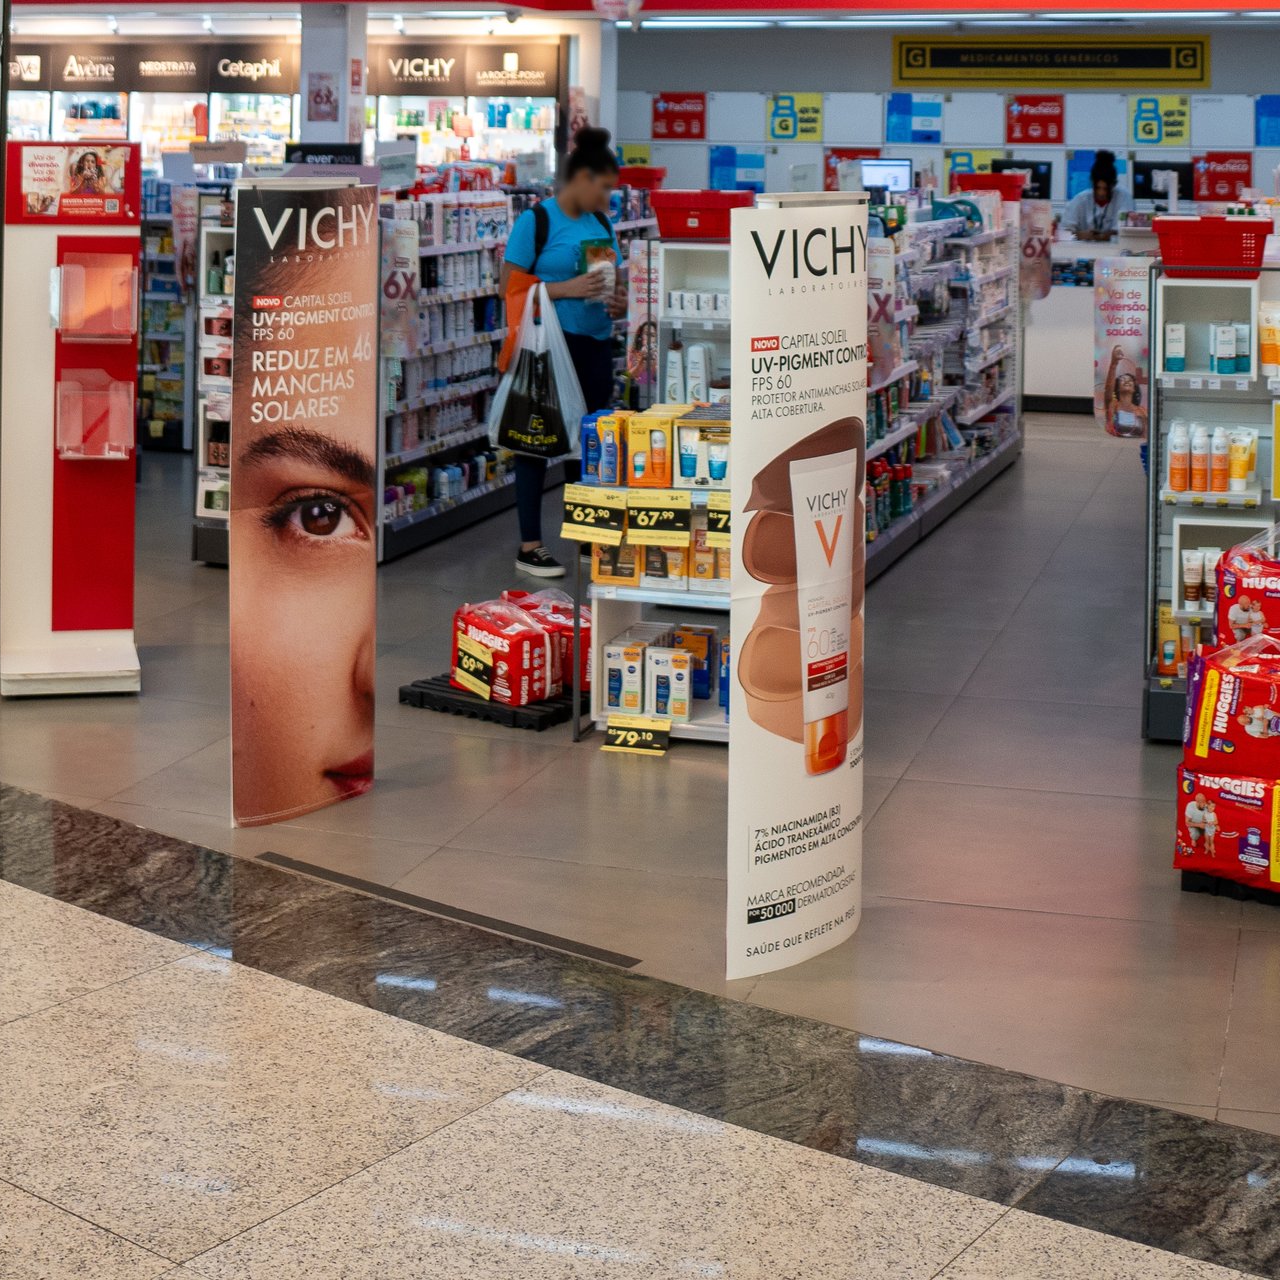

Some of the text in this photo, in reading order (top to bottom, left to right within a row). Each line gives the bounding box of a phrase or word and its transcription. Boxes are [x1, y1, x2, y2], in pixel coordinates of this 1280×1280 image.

[63, 55, 116, 77] Avène
[139, 61, 196, 73] NEOSTRATA
[388, 58, 456, 77] VICHY
[908, 49, 925, 66] G
[960, 53, 1050, 64] MEDICAMENTOS
[1178, 50, 1195, 67] G
[218, 58, 282, 82] Cetaphil
[1022, 104, 1061, 115] Pacheco
[1209, 160, 1249, 172] Pacheco
[253, 203, 374, 250] VICHY
[750, 224, 867, 280] VICHY
[1022, 238, 1050, 260] 6X
[1113, 268, 1148, 277] Pacheco
[383, 270, 417, 300] 6X
[1107, 288, 1142, 299] Vai de
[256, 298, 281, 307] NOVO
[283, 294, 326, 309] CAPITAL
[1099, 300, 1150, 312] diversão.
[252, 308, 340, 327] UV-PIGMENT
[1107, 314, 1142, 325] Vai de
[253, 327, 295, 341] FPS 60
[754, 329, 848, 350] NOVO CAPITAL SOLEIL
[1106, 326, 1143, 337] saúde.
[252, 348, 320, 372] REDUZ
[324, 345, 349, 367] EM
[751, 349, 835, 375] UV-PIGMENT
[251, 368, 354, 398] MANCHAS
[752, 374, 792, 392] FPS 60
[751, 382, 851, 406] PROTETOR ANTIMANCHAS
[751, 408, 774, 420] ALTA
[807, 488, 848, 513] VICHY
[572, 506, 610, 523] 62,90
[637, 510, 675, 526] 67,99
[468, 625, 510, 653] HUGGIES
[1213, 673, 1235, 733] HUGGIES
[615, 730, 654, 746] 79,10
[1198, 773, 1265, 798] HUGGIES
[754, 804, 841, 839] 7% NIACINAMIDA (B3)
[754, 818, 841, 852] ÁCIDO TRANEXÂMICO
[754, 833, 836, 865] PIGMENTOS EM ALTA
[746, 865, 845, 906] MARCA RECOMENDADA
[760, 906, 774, 920] 50
[774, 901, 794, 917] 000
[746, 915, 844, 957] SAÚDE QUE REFLETE NA
